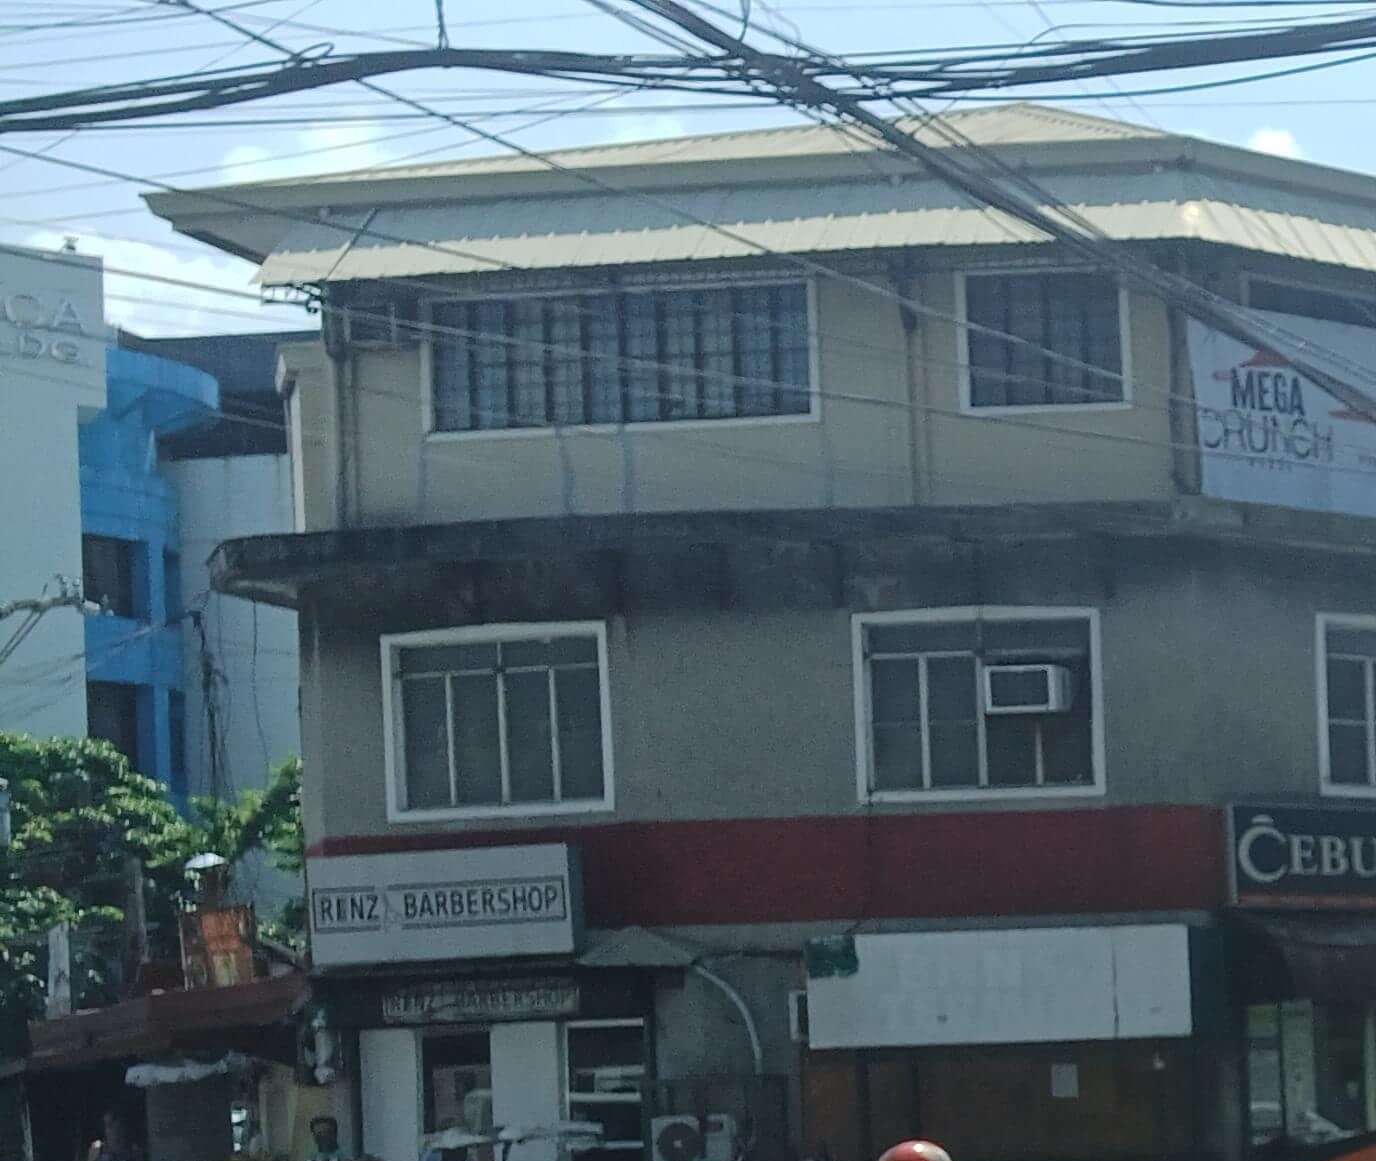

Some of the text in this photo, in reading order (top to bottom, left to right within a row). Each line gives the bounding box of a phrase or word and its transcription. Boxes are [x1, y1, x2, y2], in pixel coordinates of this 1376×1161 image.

[1230, 369, 1306, 417] MEGA
[320, 885, 558, 922] RENZ BARBERSHOP
